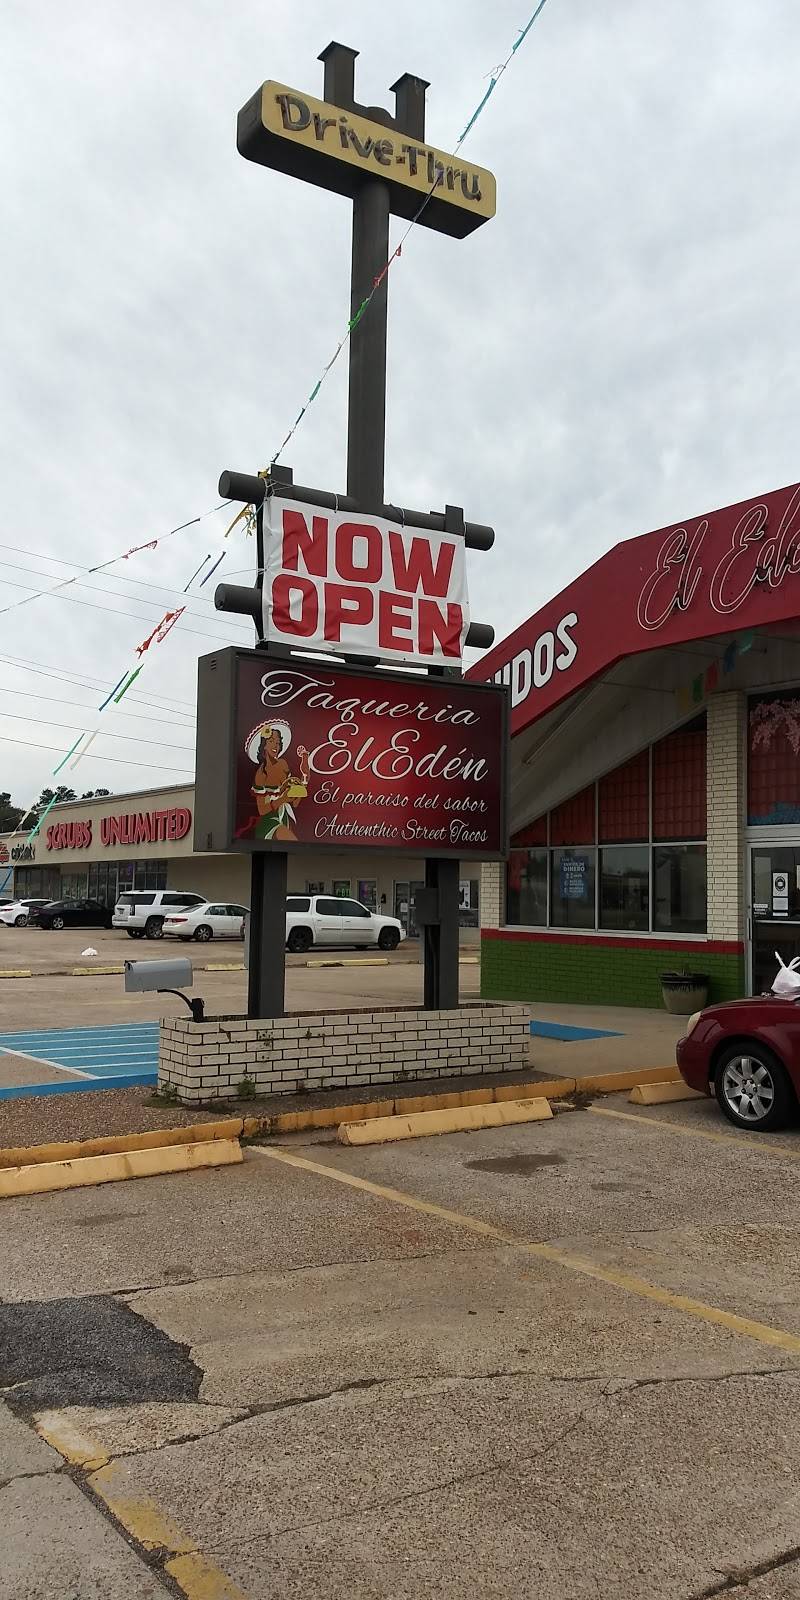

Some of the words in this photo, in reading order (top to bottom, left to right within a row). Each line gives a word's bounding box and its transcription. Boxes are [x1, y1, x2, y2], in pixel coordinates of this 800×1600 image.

[275, 92, 483, 202] Drive-Thru
[281, 508, 457, 598] NOW
[636, 519, 710, 631] El
[271, 573, 463, 658] OPEN
[260, 669, 481, 725] Taqueria
[47, 820, 92, 850] SCRUBS
[101, 808, 192, 845] UNLIMITED
[313, 781, 340, 804] El
[342, 792, 409, 808] paraiso
[413, 793, 439, 809] del
[443, 796, 488, 813] sabor
[314, 814, 399, 838] Authenthic
[401, 818, 447, 841] Street
[449, 818, 488, 844] Tacos
